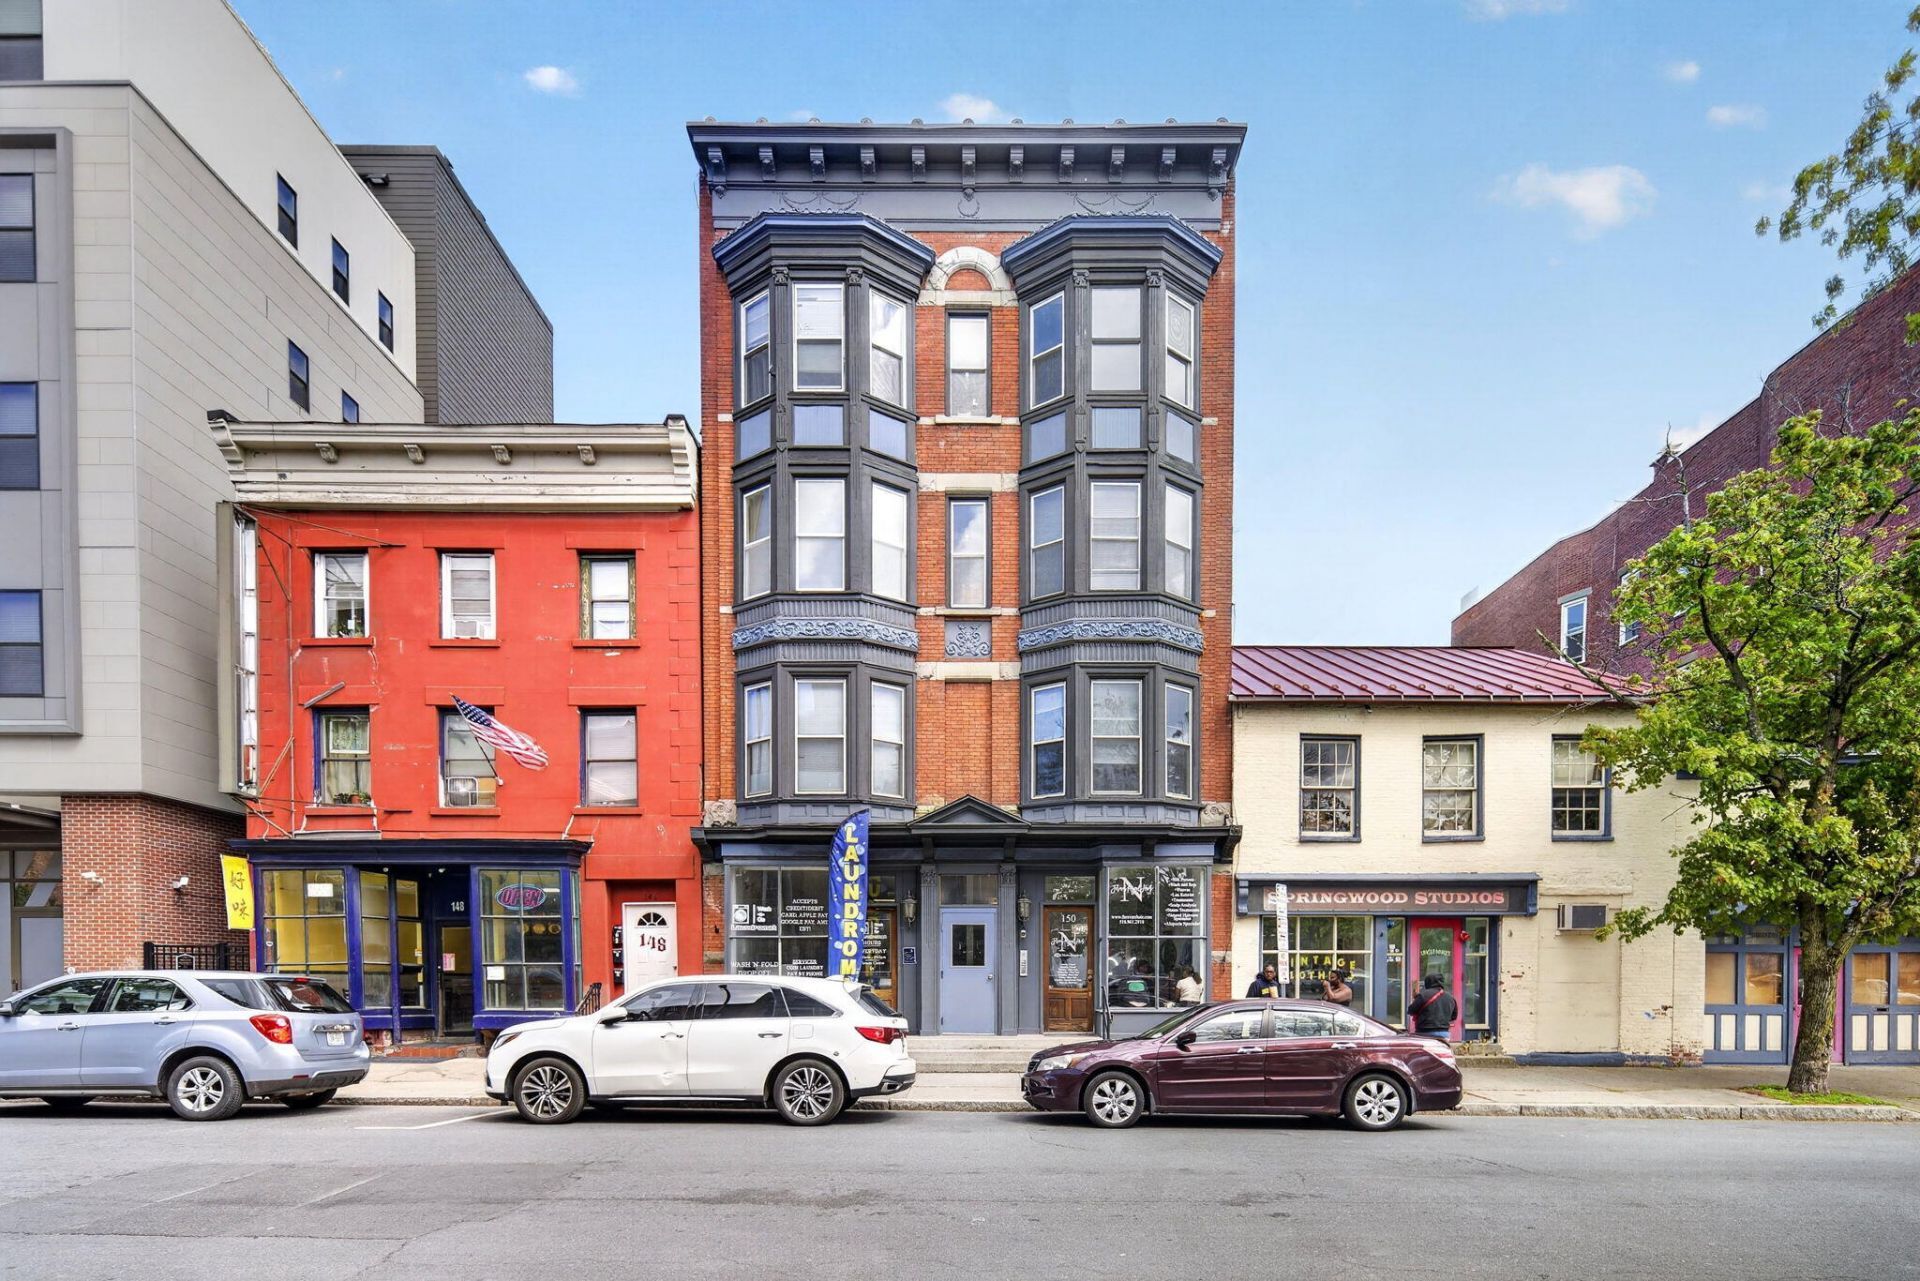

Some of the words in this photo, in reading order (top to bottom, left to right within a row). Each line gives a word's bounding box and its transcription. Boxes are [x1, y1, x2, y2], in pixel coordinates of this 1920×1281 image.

[501, 888, 542, 907] OPEN
[1415, 891, 1505, 905] STUDIOS
[450, 901, 465, 912] 148
[1061, 914, 1077, 923] 150
[640, 933, 666, 952] 148
[1290, 955, 1356, 970] INTAGE
